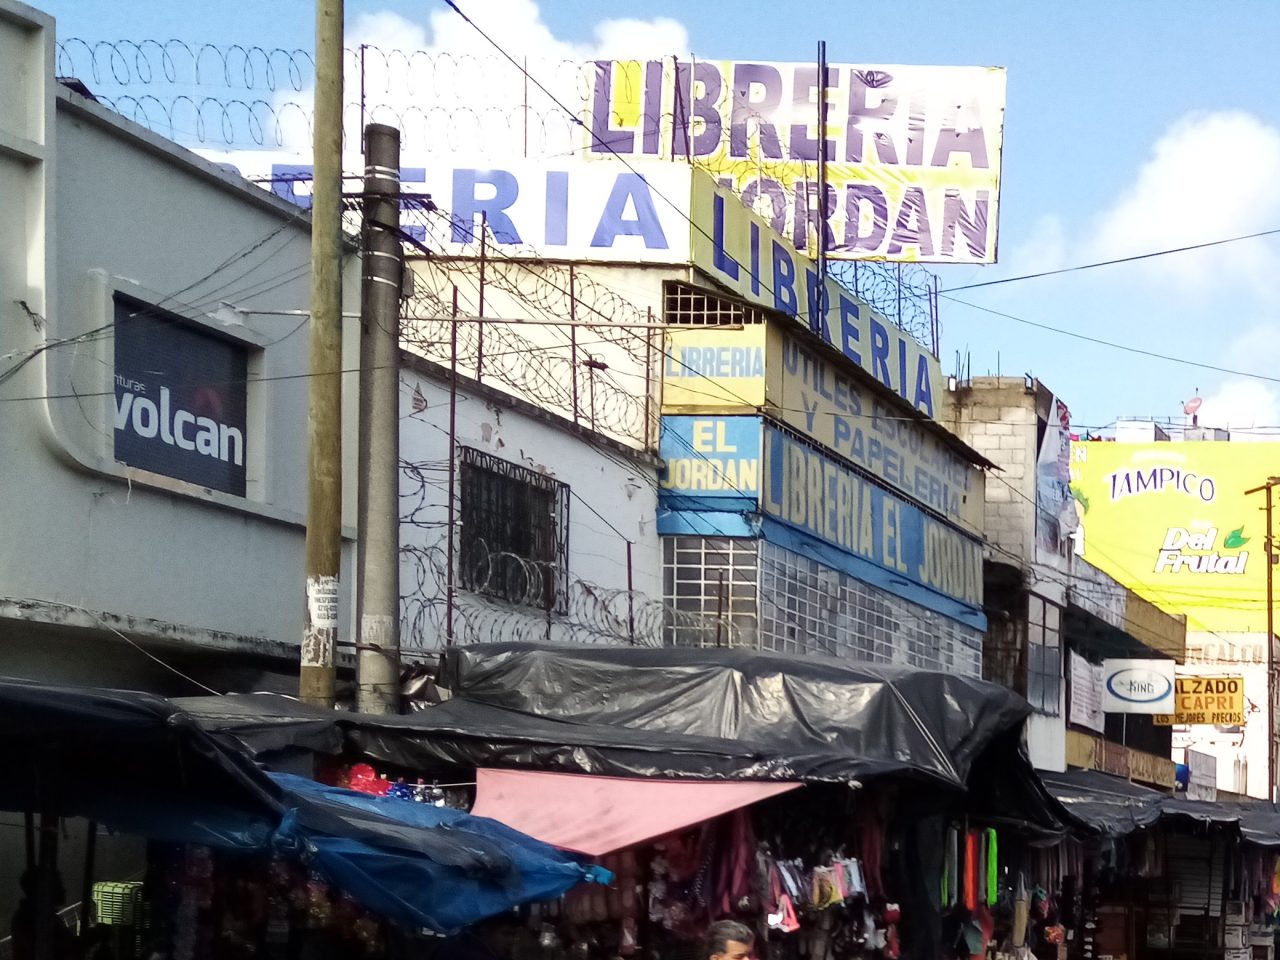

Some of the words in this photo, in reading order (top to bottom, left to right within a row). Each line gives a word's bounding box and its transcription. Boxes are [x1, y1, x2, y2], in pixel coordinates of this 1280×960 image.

[591, 60, 990, 168] LIBRERIA
[718, 178, 988, 259] ORDAN
[712, 191, 932, 420] LIBRERIA
[666, 346, 765, 378] LIBRERIA
[782, 337, 863, 418] UTILES
[114, 385, 244, 467] volcan
[692, 421, 737, 453] EL
[661, 458, 758, 491] JORDAN
[801, 400, 815, 434] Y
[833, 418, 962, 519] PAPELERIA
[763, 428, 874, 562] LIBRERIA
[882, 495, 908, 574] EL
[1154, 550, 1249, 574] Frutal
[1162, 527, 1218, 550] Del
[1175, 712, 1205, 723] MEJORES
[1212, 712, 1241, 723] PRECIOS
[1181, 696, 1233, 710] CAPRI
